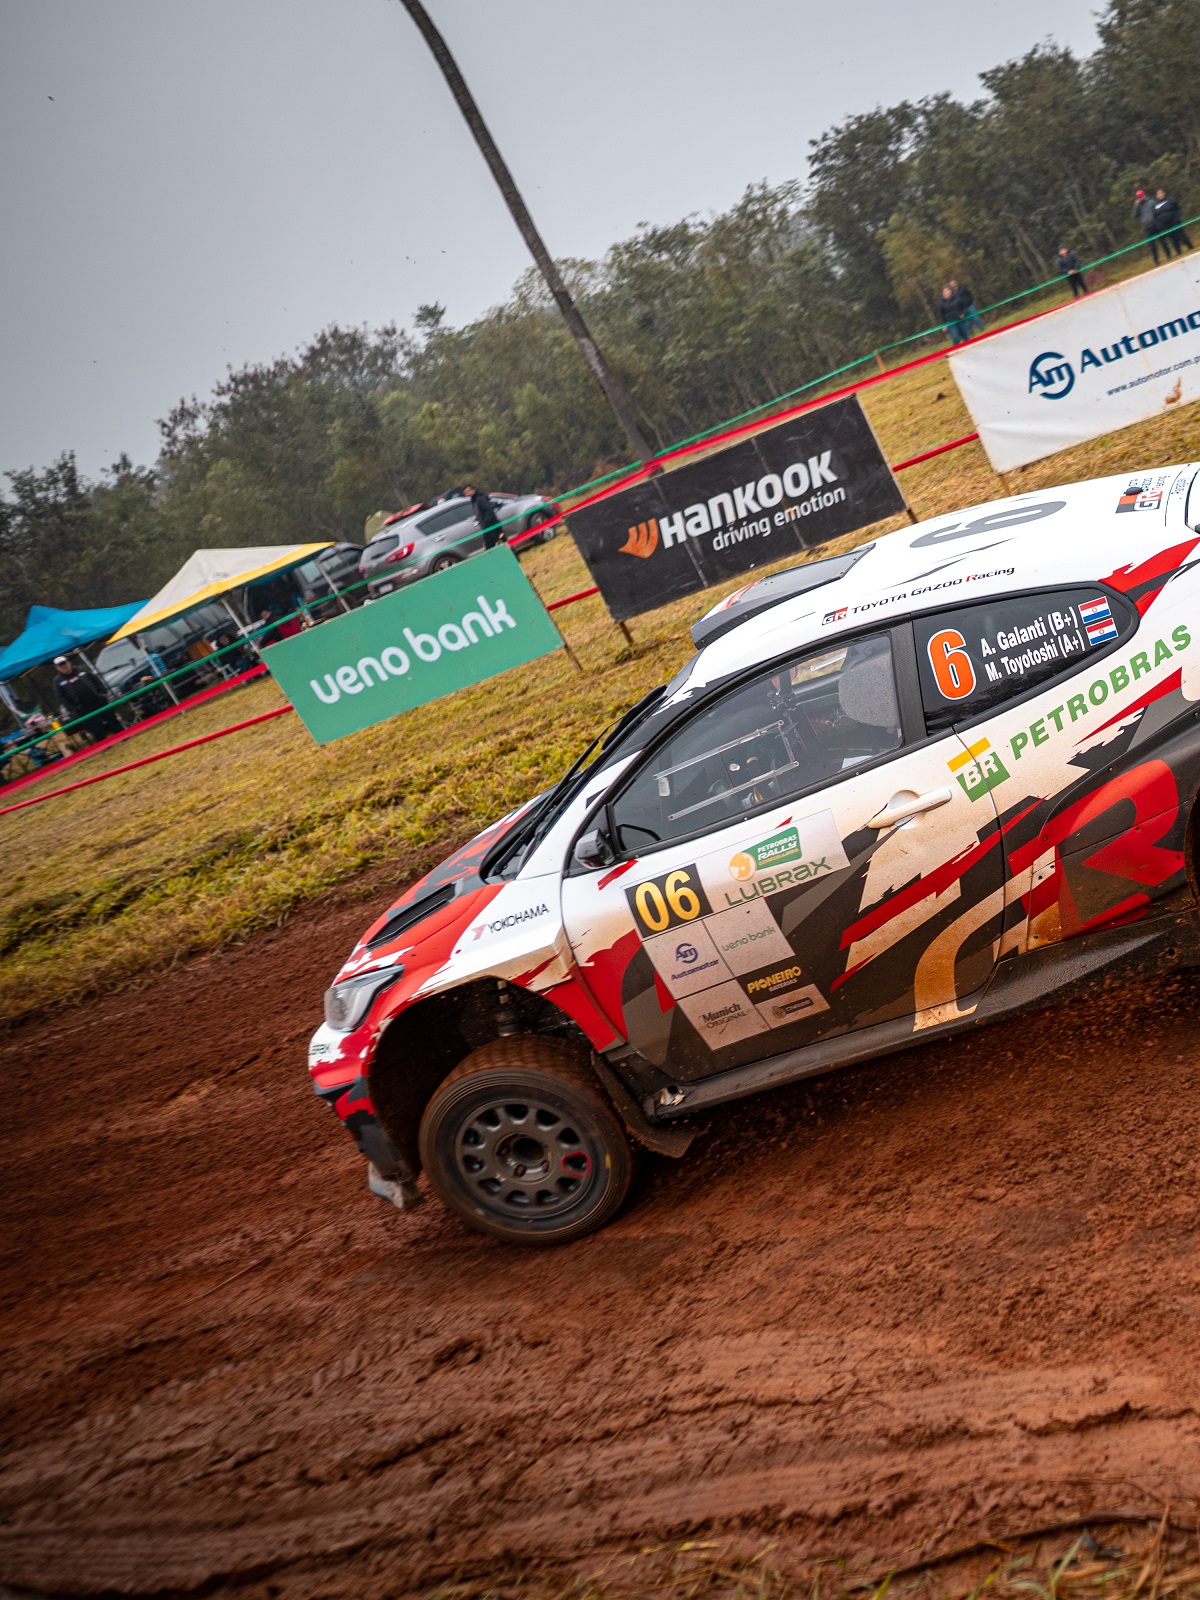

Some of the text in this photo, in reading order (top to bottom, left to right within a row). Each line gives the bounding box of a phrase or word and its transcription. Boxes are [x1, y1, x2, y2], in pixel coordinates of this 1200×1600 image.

[712, 486, 847, 551] driving emotion
[852, 593, 906, 614] TOYOTA
[911, 579, 962, 596] GAZOO
[965, 567, 1015, 584] Racing
[309, 594, 517, 706] ueno bank
[980, 606, 1078, 658] A. Galanti (B+)
[926, 628, 977, 700] 6
[984, 629, 1086, 682] M. Toyotoshi (A+)
[1009, 624, 1192, 761] PETROBRAS
[963, 751, 1000, 791] BR
[757, 834, 797, 853] PETROBRAS
[757, 841, 797, 861] RALLY
[487, 903, 550, 934] YOKOHAMA
[635, 869, 701, 932] 06
[721, 926, 776, 952] ueno bank
[671, 959, 719, 981] Automotor
[746, 966, 802, 994] PIONEIRO
[702, 1002, 741, 1023] Munich
[706, 1010, 748, 1029] ORIGINAL
